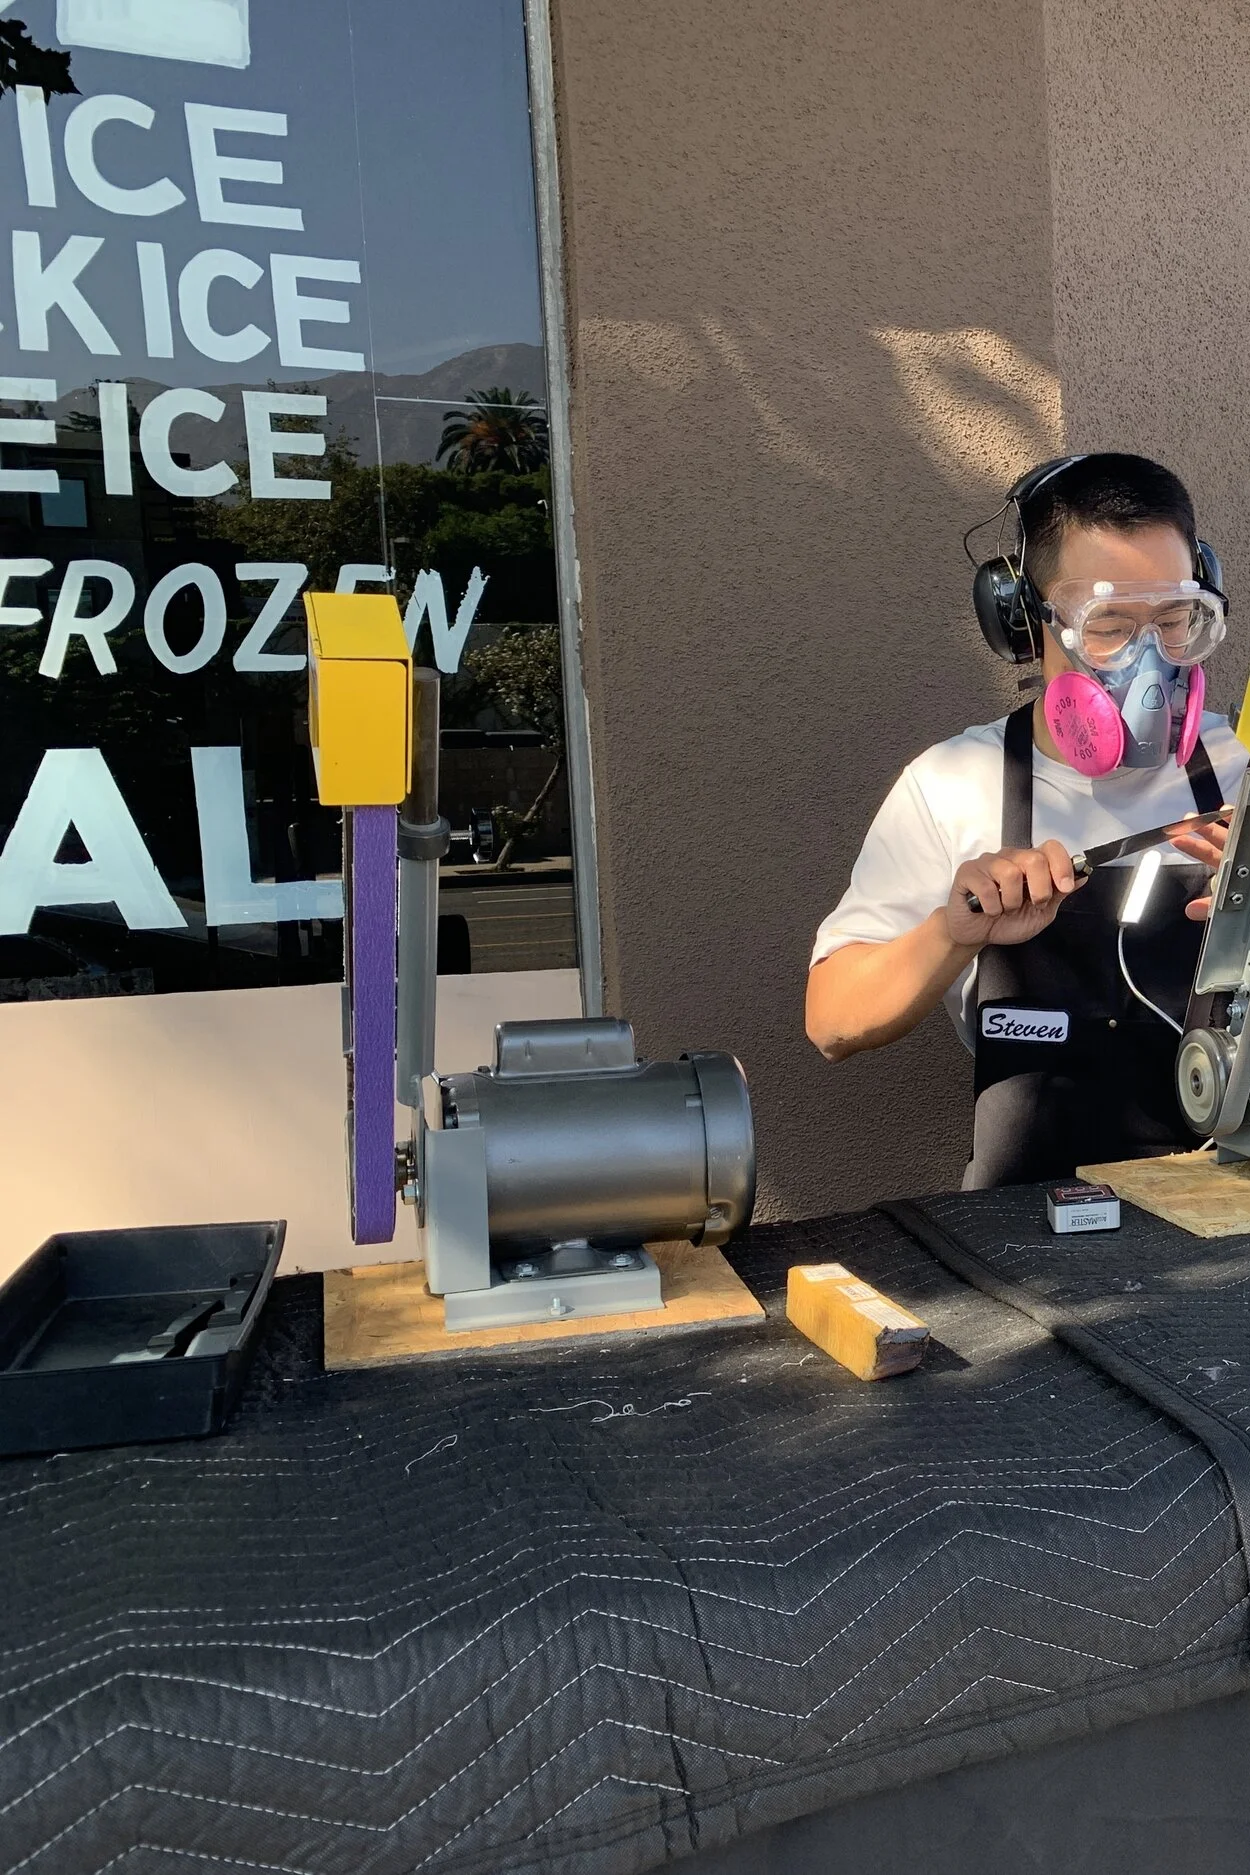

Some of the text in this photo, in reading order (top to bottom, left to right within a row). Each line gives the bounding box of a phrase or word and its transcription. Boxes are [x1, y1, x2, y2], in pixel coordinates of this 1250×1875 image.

[16, 84, 304, 231] ICE
[0, 231, 365, 372] K ICE
[99, 382, 332, 499] ICE
[985, 1013, 1064, 1039] Steven
